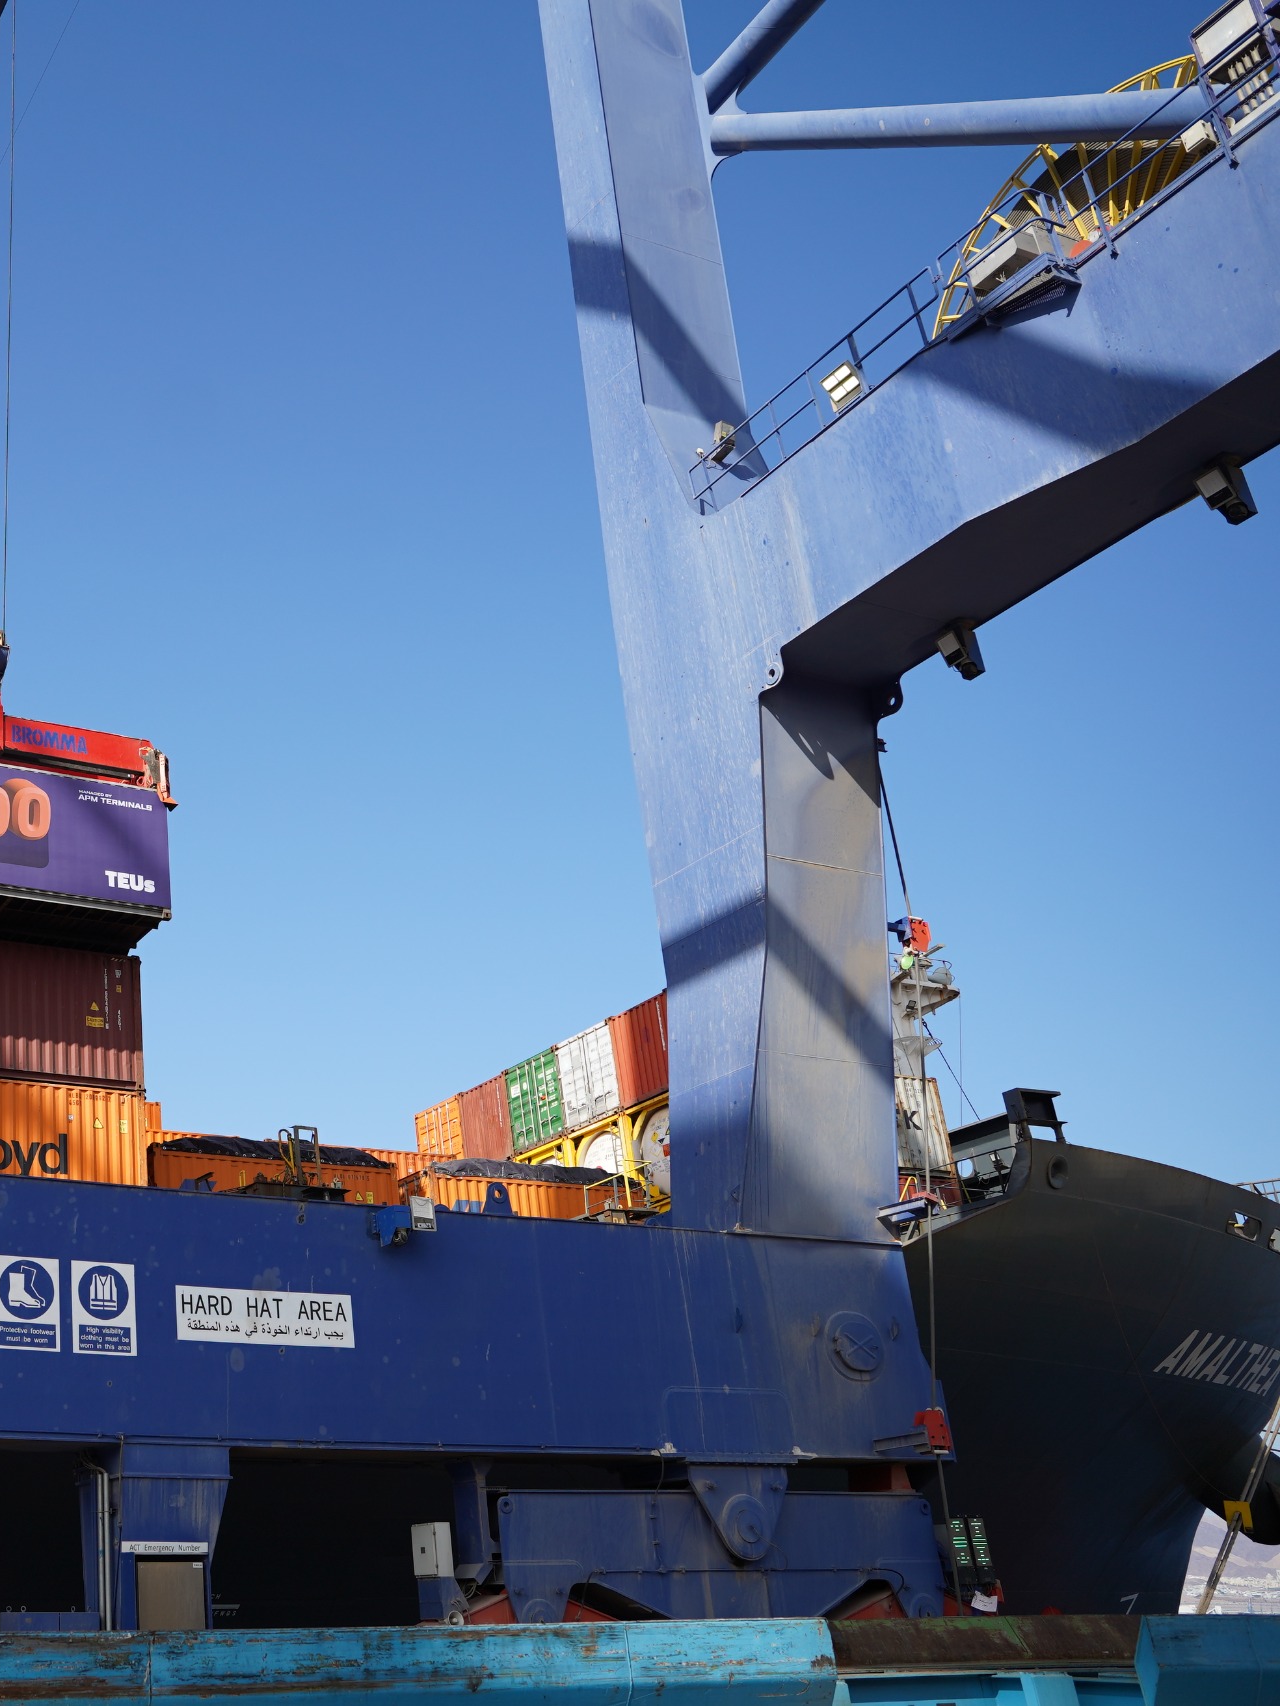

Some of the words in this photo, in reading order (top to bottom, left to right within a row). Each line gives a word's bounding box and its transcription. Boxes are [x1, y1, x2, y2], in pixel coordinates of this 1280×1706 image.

[11, 724, 88, 755] BROMMA
[78, 794, 98, 803] APM
[100, 797, 153, 812] TERMINALS
[104, 870, 156, 894] TEUs
[181, 1293, 233, 1316] HARD
[246, 1296, 283, 1319] HAT
[297, 1300, 348, 1322] AREA
[0, 1325, 28, 1334] Protective
[30, 1327, 56, 1336] footwear
[86, 1326, 100, 1335] High
[102, 1327, 124, 1336] visibility
[186, 1318, 221, 1332] المنطقة
[225, 1320, 241, 1333] هذه
[244, 1321, 258, 1339] في
[261, 1322, 291, 1338] الخوذة
[80, 1334, 103, 1343] clothing
[294, 1326, 321, 1340] ارتداء
[324, 1330, 344, 1341] يجب
[144, 1544, 175, 1553] Emergency
[178, 1544, 201, 1552] Number
